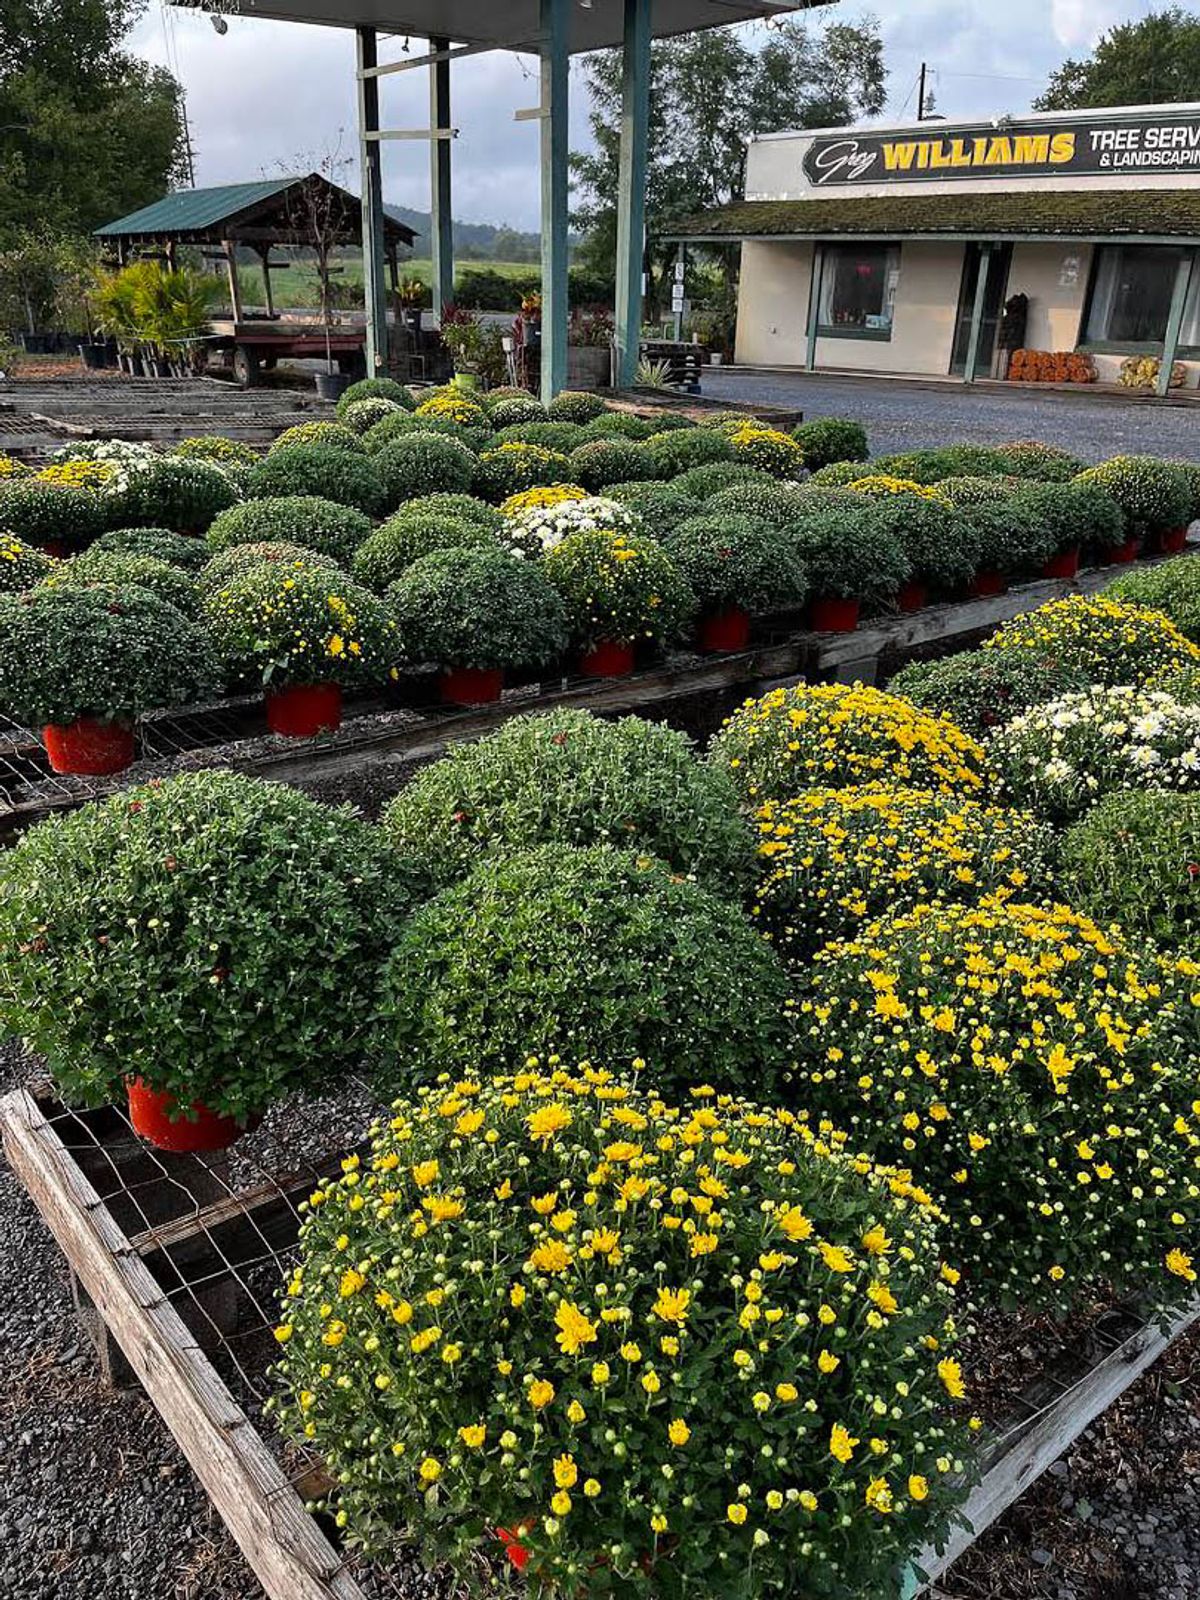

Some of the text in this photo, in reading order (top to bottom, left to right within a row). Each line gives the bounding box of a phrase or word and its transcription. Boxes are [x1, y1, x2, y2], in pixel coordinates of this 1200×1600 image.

[1089, 126, 1200, 151] TREE SERV
[815, 133, 1076, 184] Greg WILLIAMS
[1099, 152, 1111, 167] &
